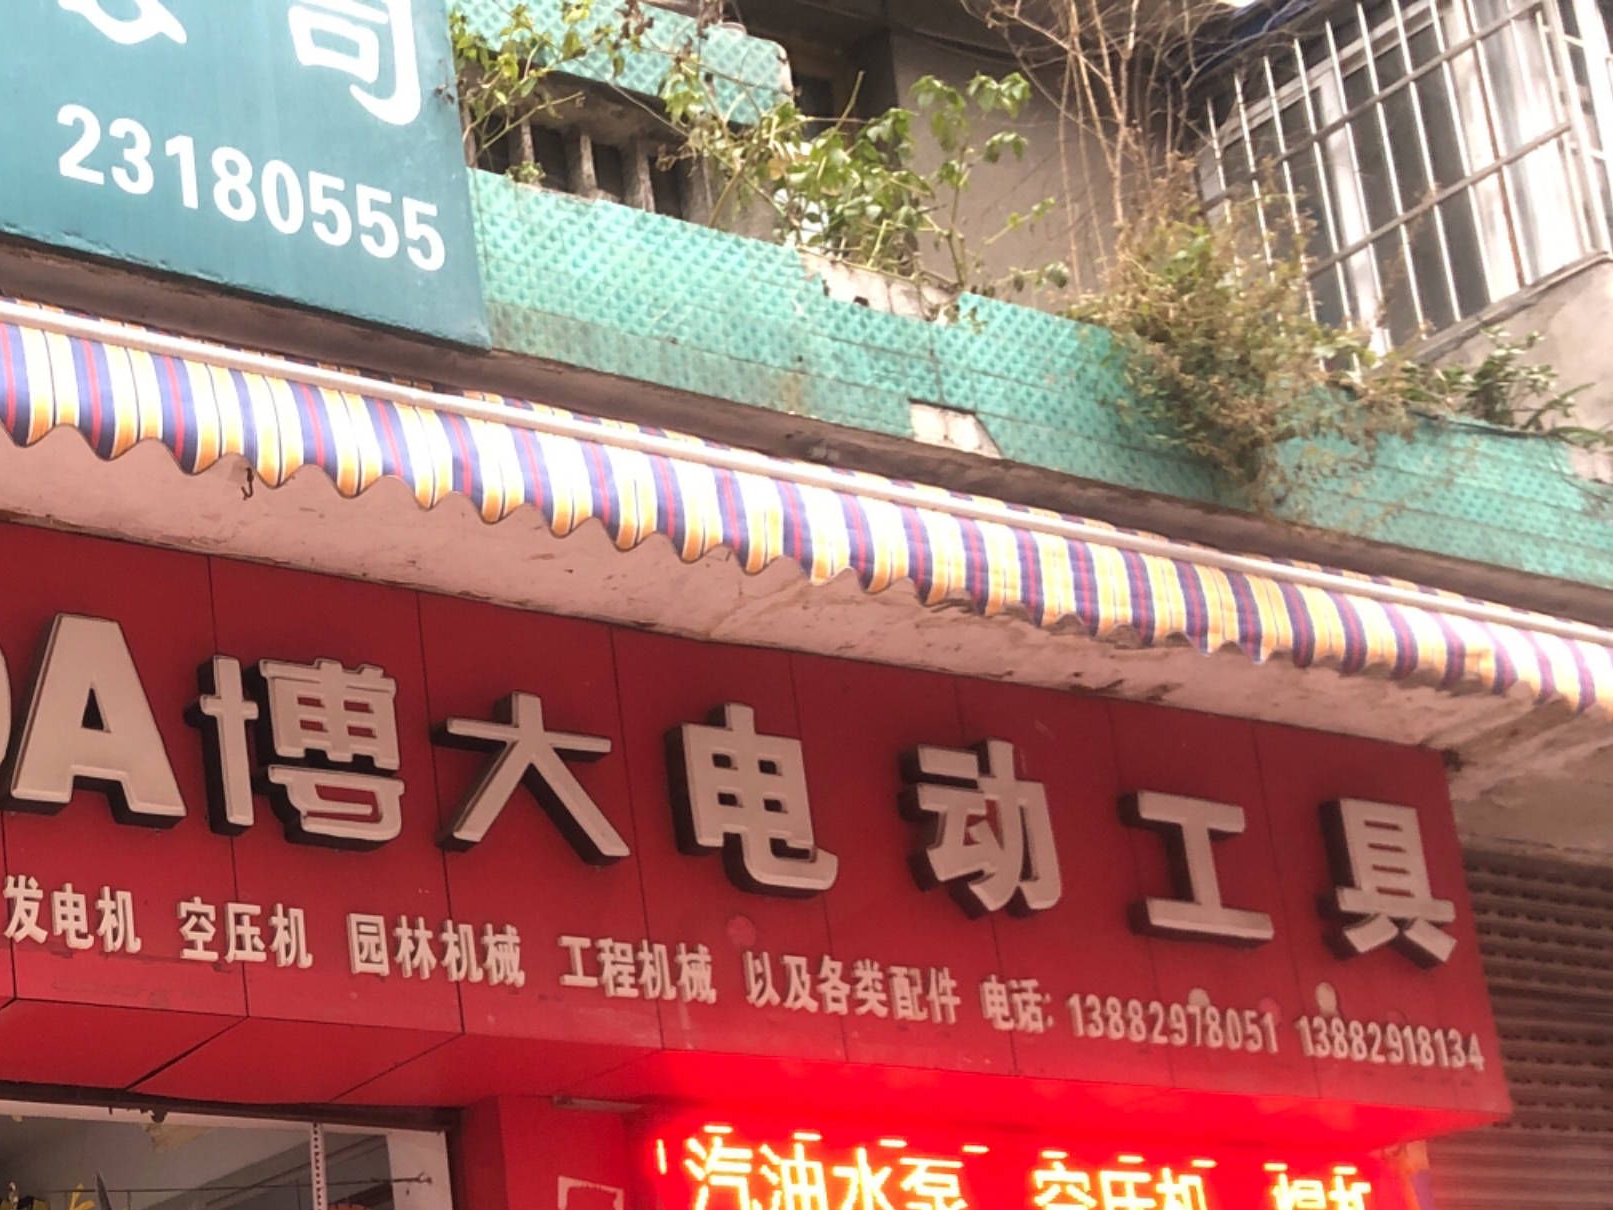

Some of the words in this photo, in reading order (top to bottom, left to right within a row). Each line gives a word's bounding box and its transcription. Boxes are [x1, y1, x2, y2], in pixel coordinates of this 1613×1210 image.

[57, 0, 421, 126] 司
[56, 102, 447, 272] 23180555
[2, 874, 143, 955] 发电机
[178, 896, 313, 969] 空压机
[346, 912, 526, 988] 园林机械
[557, 934, 717, 1004] 工程机械
[743, 950, 961, 1025] 以及各类配件
[1066, 993, 1280, 1054] 13882978051
[1294, 1015, 1485, 1072] 13882918134
